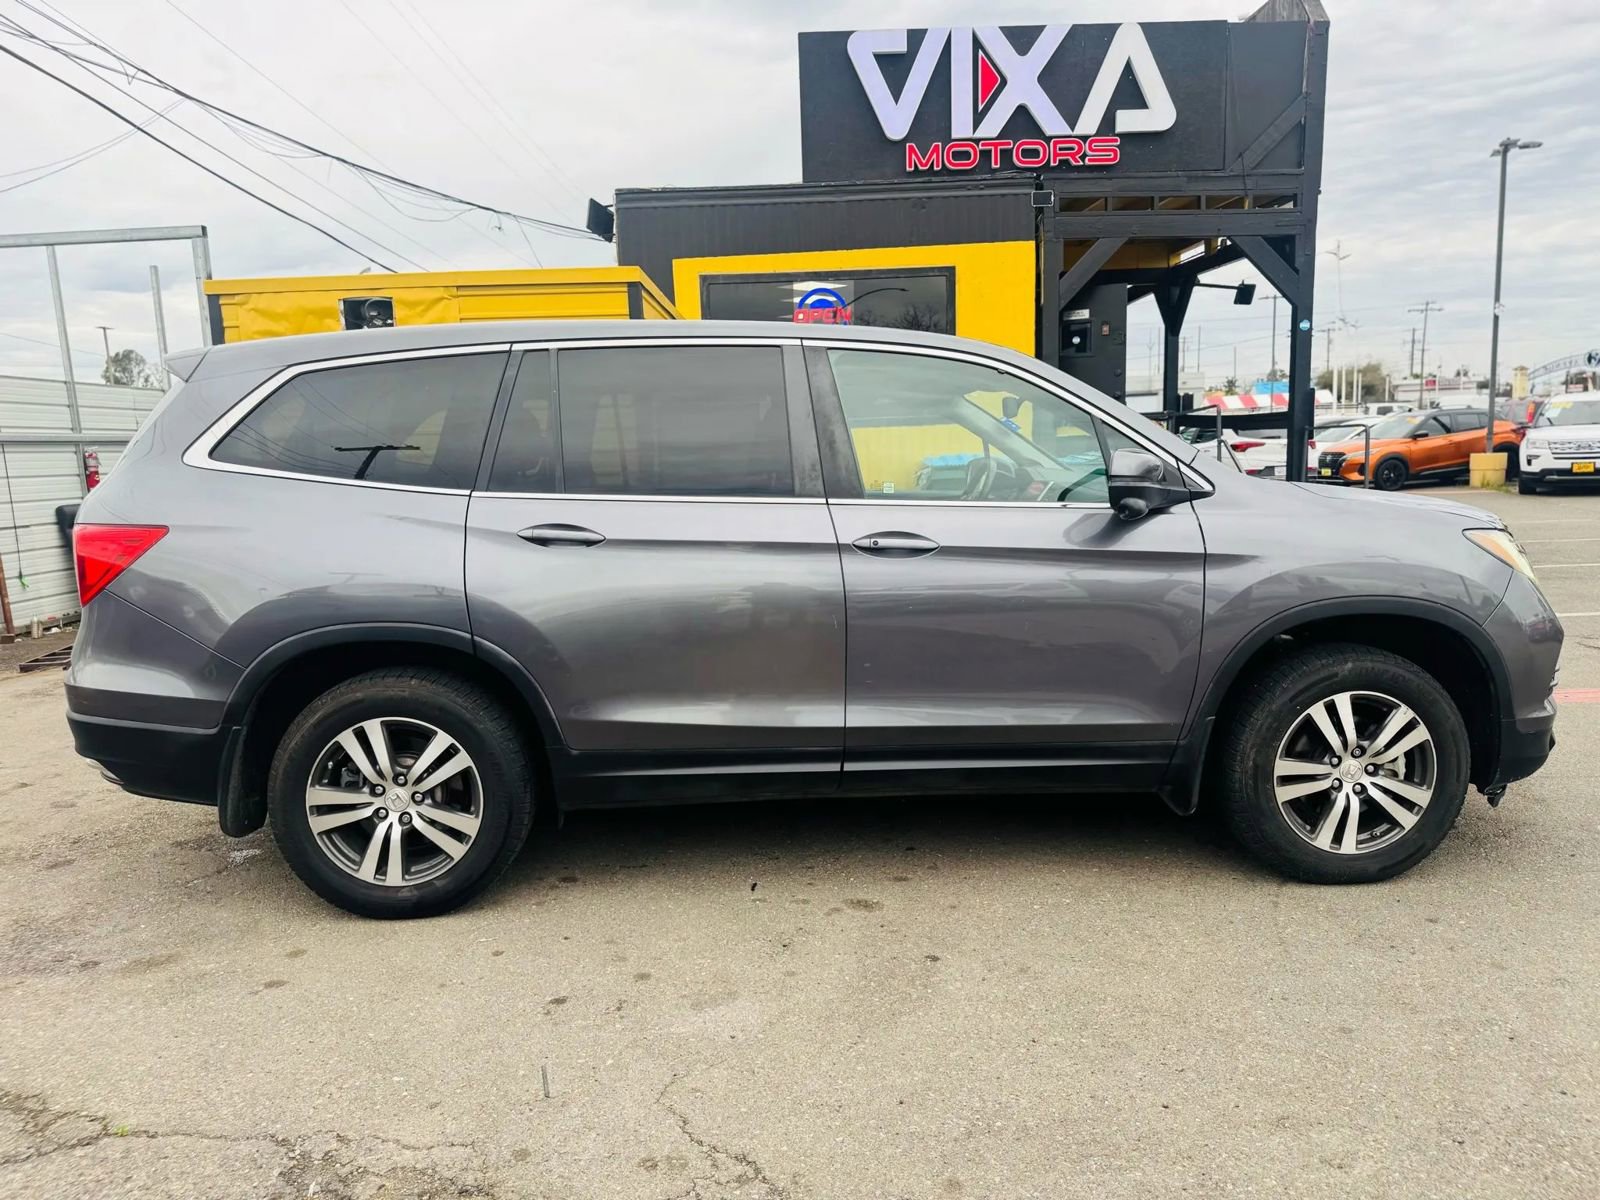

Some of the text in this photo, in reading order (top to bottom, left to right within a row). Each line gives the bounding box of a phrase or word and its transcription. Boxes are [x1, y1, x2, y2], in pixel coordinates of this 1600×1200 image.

[847, 22, 1177, 141] VIXA
[906, 136, 1121, 172] MOTORS
[793, 306, 853, 324] OPEN
